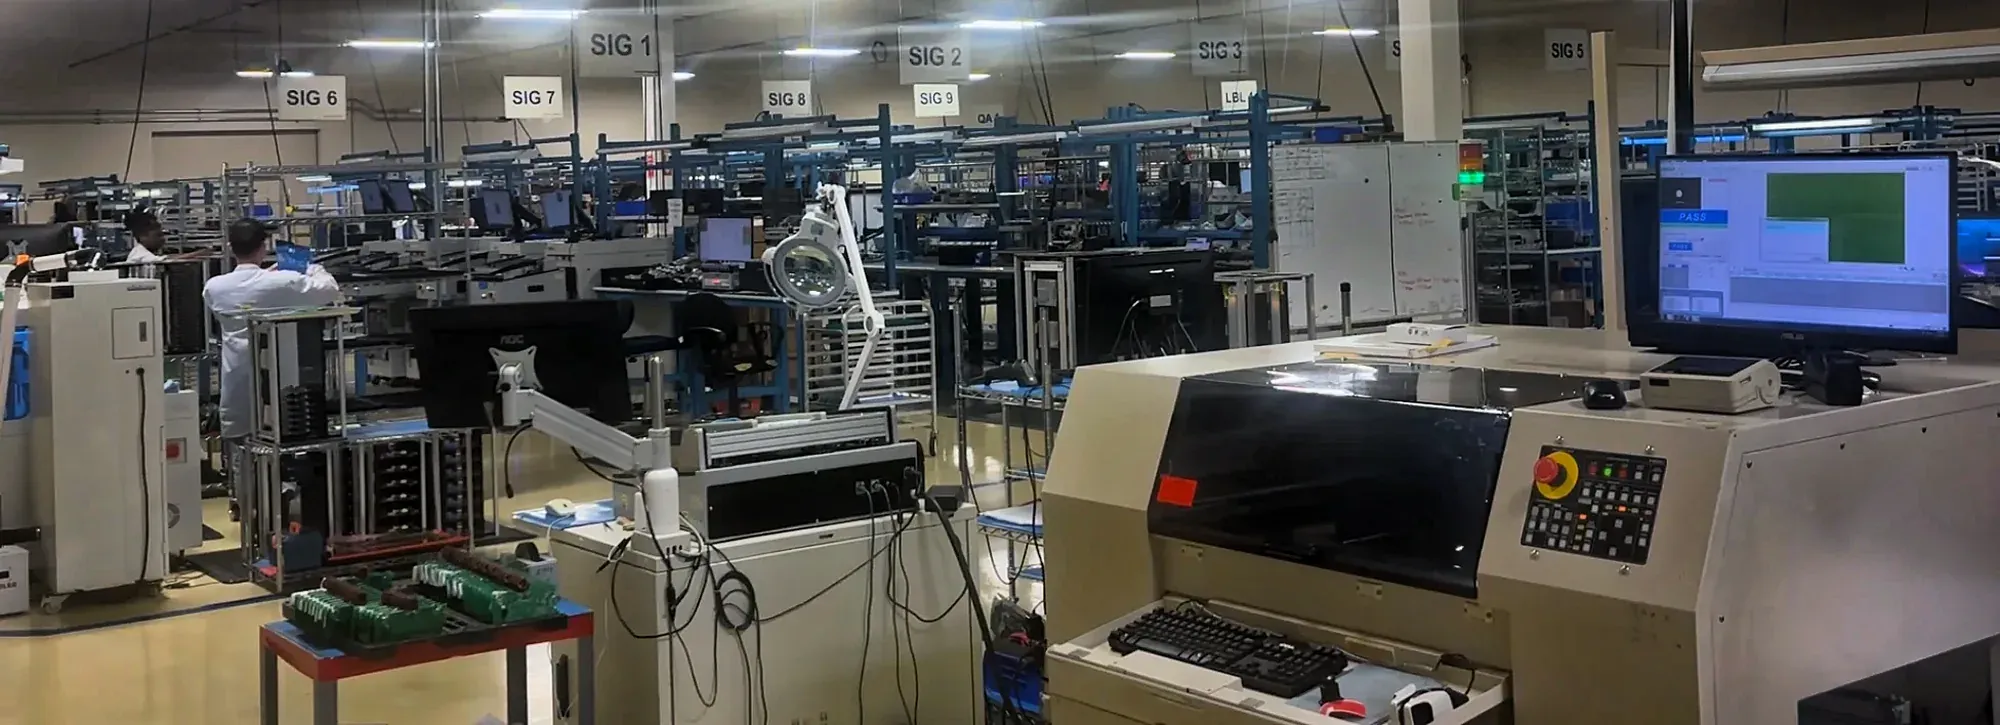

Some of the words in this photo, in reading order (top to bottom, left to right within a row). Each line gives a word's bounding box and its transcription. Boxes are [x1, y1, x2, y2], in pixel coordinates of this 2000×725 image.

[590, 33, 633, 56] SIG
[640, 34, 651, 57] 1
[1199, 41, 1228, 60] SIG
[1232, 41, 1242, 60] 3
[1551, 42, 1574, 59] SIG
[1576, 43, 1585, 59] 5
[909, 46, 945, 67] SIG
[951, 47, 962, 67] 2
[286, 89, 321, 106] SIG
[327, 90, 338, 106] 6
[512, 90, 541, 105] SIG
[546, 90, 556, 105] 7
[768, 92, 794, 107] SIG
[797, 92, 806, 106] 8
[920, 92, 942, 105] SIG
[946, 91, 954, 104] 9
[1225, 92, 1246, 103] LBL
[977, 113, 993, 124] QA
[1678, 212, 1707, 222] PASS
